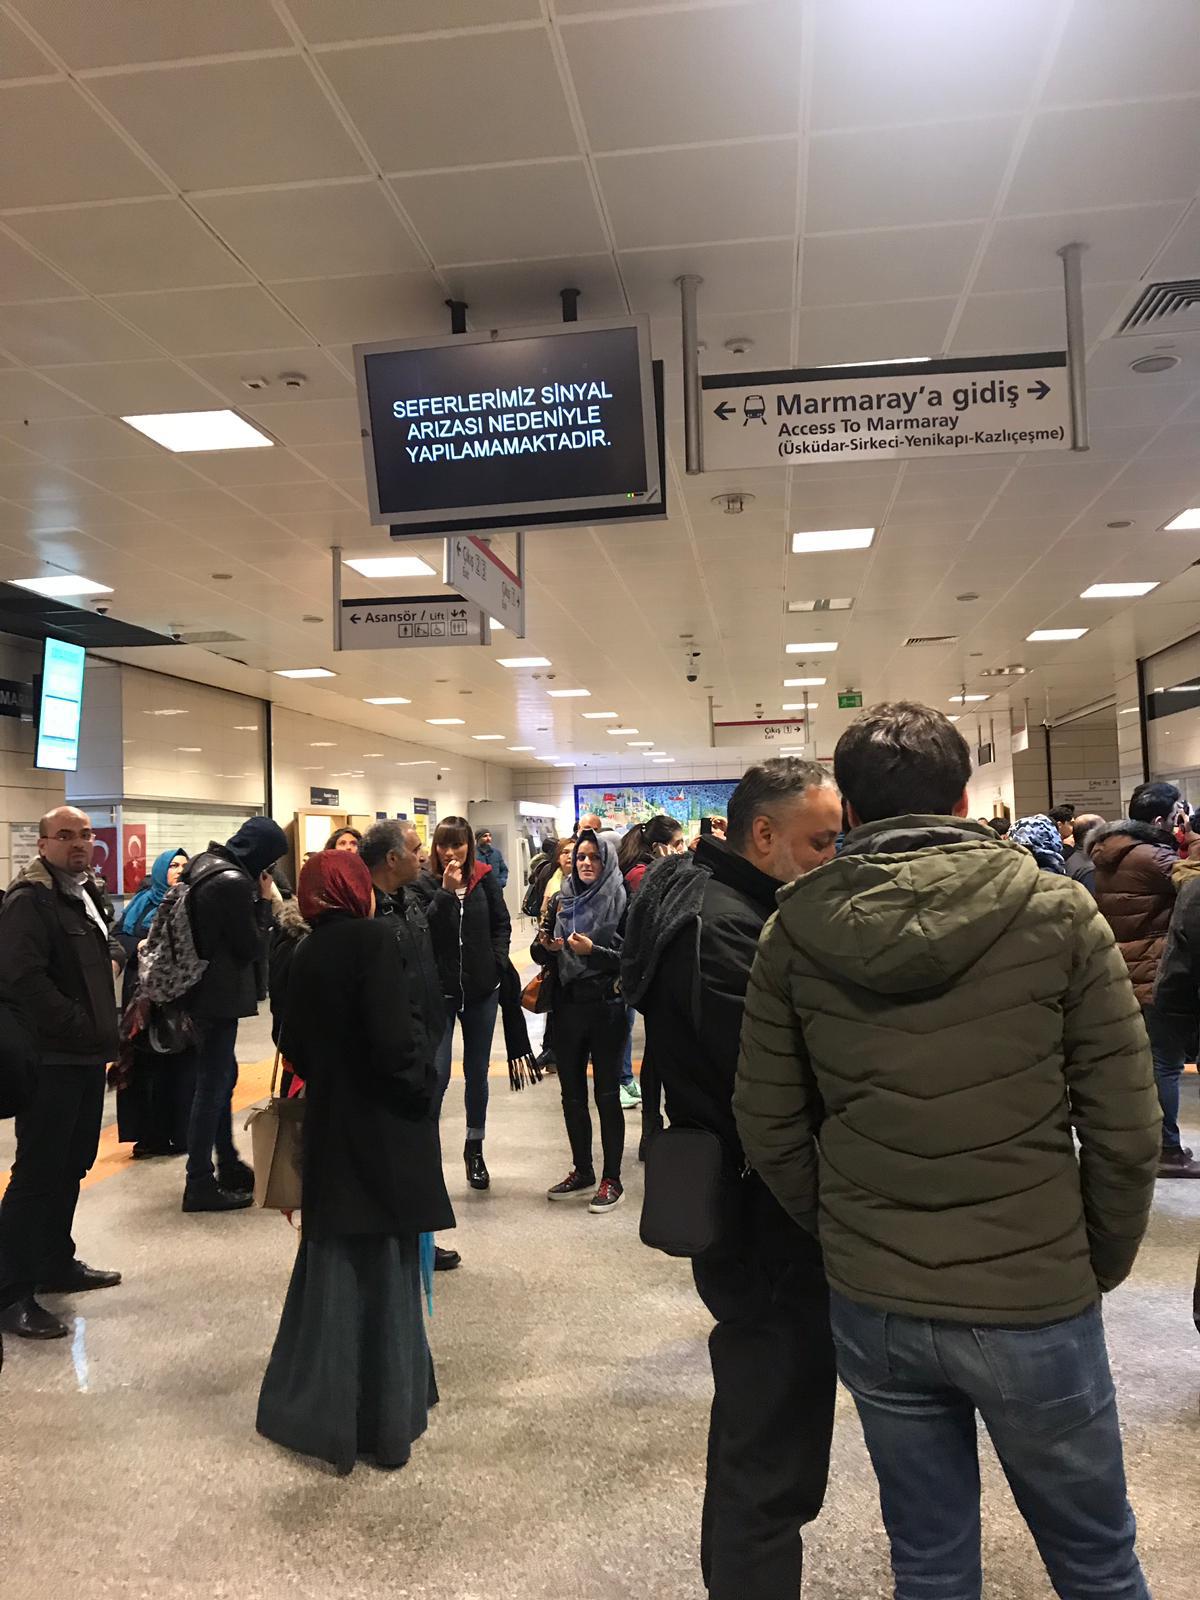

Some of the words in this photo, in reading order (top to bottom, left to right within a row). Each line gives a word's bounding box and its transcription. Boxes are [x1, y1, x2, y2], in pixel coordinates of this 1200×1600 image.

[393, 386, 536, 418] SEFERLERİMİZ
[541, 381, 613, 405] SİNYAL
[777, 386, 943, 416] Marmaray'a
[952, 380, 1019, 411] gidiş
[407, 417, 483, 440] ARIZASI
[488, 405, 601, 434] NEDENİYLE
[778, 422, 836, 437] Access
[841, 419, 861, 433] To
[867, 415, 959, 431] Marmaray
[405, 429, 611, 463] YAPILAMAMAKTADIR.
[778, 426, 1065, 457] (Üsküdar-Sirkeci-Yenikapı-Kazlıçeşme)
[365, 610, 417, 623] Asansör
[421, 610, 426, 620] /
[430, 611, 444, 621] Lift
